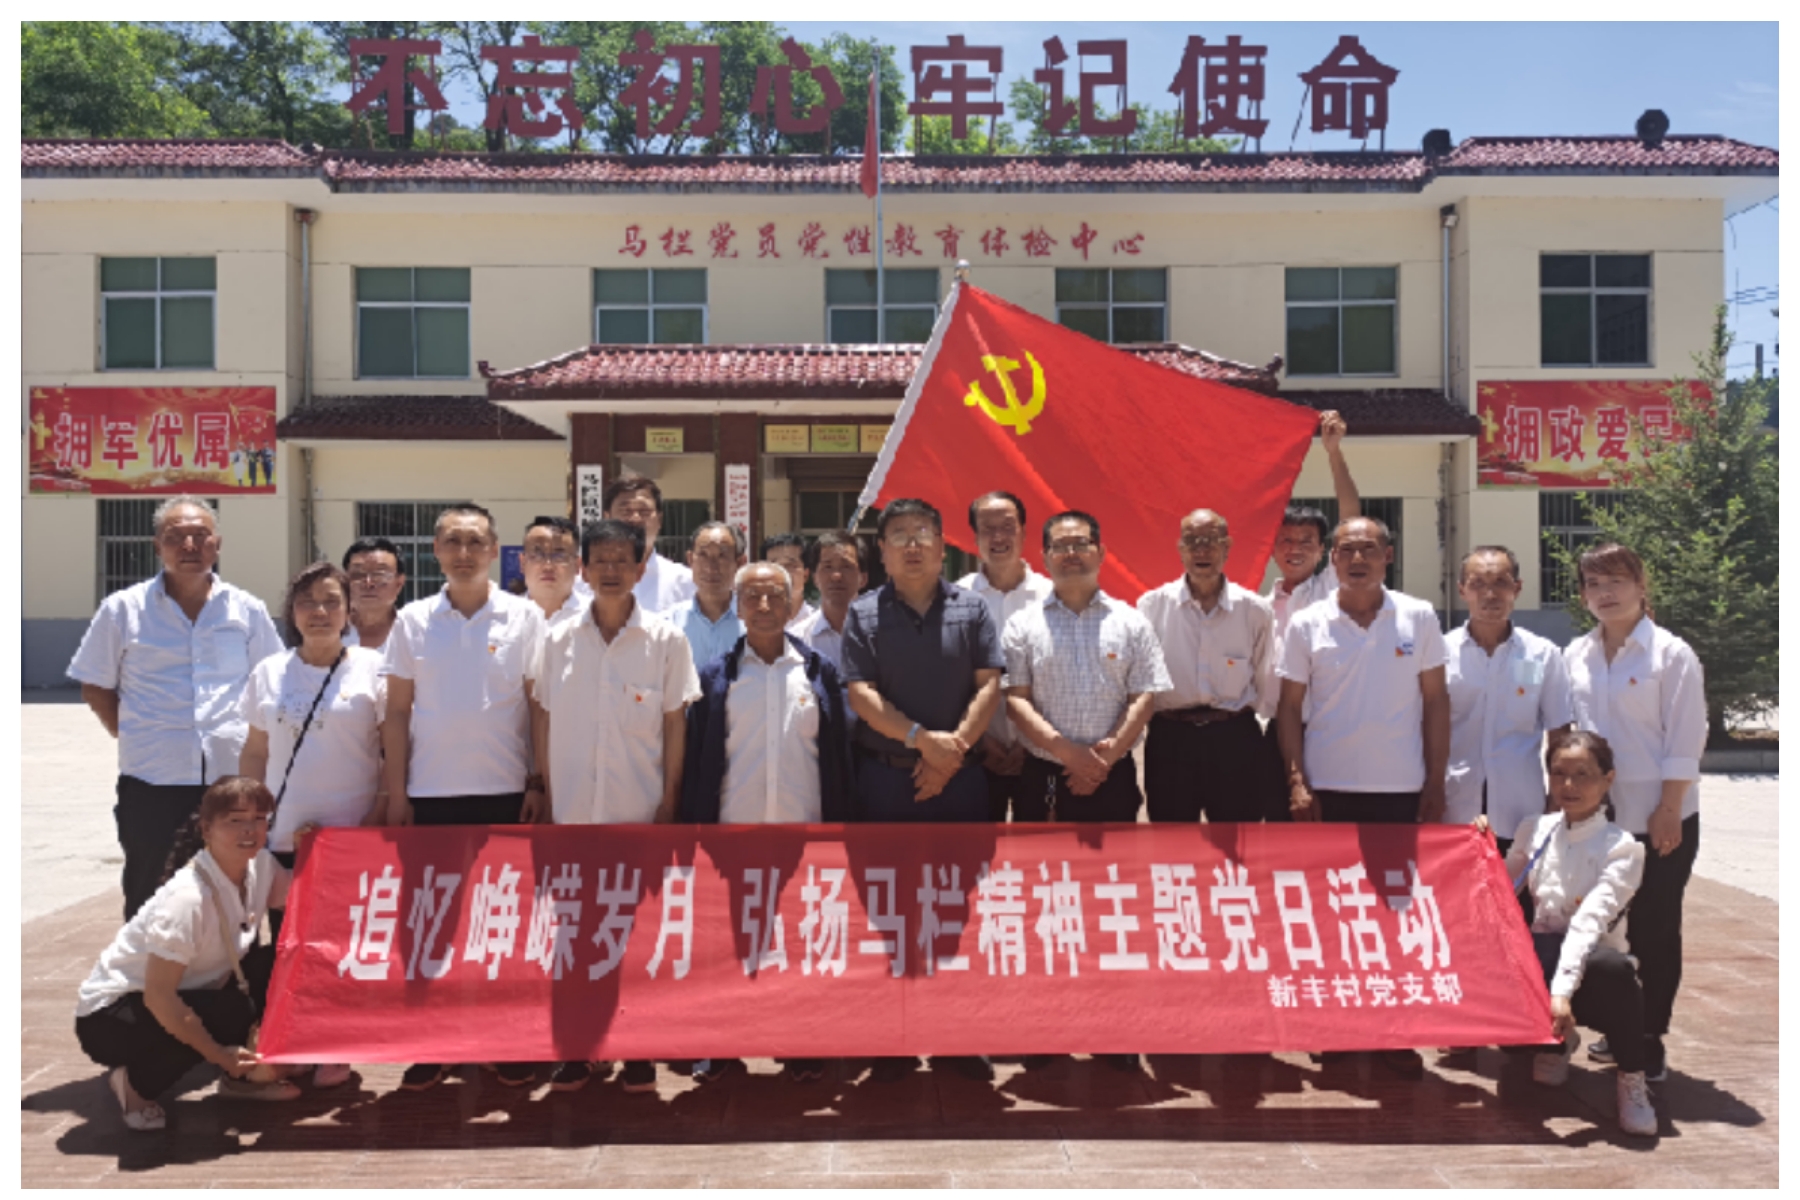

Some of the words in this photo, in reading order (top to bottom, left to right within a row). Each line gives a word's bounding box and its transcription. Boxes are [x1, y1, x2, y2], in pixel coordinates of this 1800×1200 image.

[344, 30, 846, 139] 不忘初心
[908, 34, 1401, 140] 牢记使命
[53, 411, 231, 471] 拥军优属
[337, 863, 697, 981] 追忆峥嵘岁月
[741, 861, 1451, 977] 弘扬马栏精神主题党日活动
[1267, 972, 1462, 1008] 新丰村党支部
